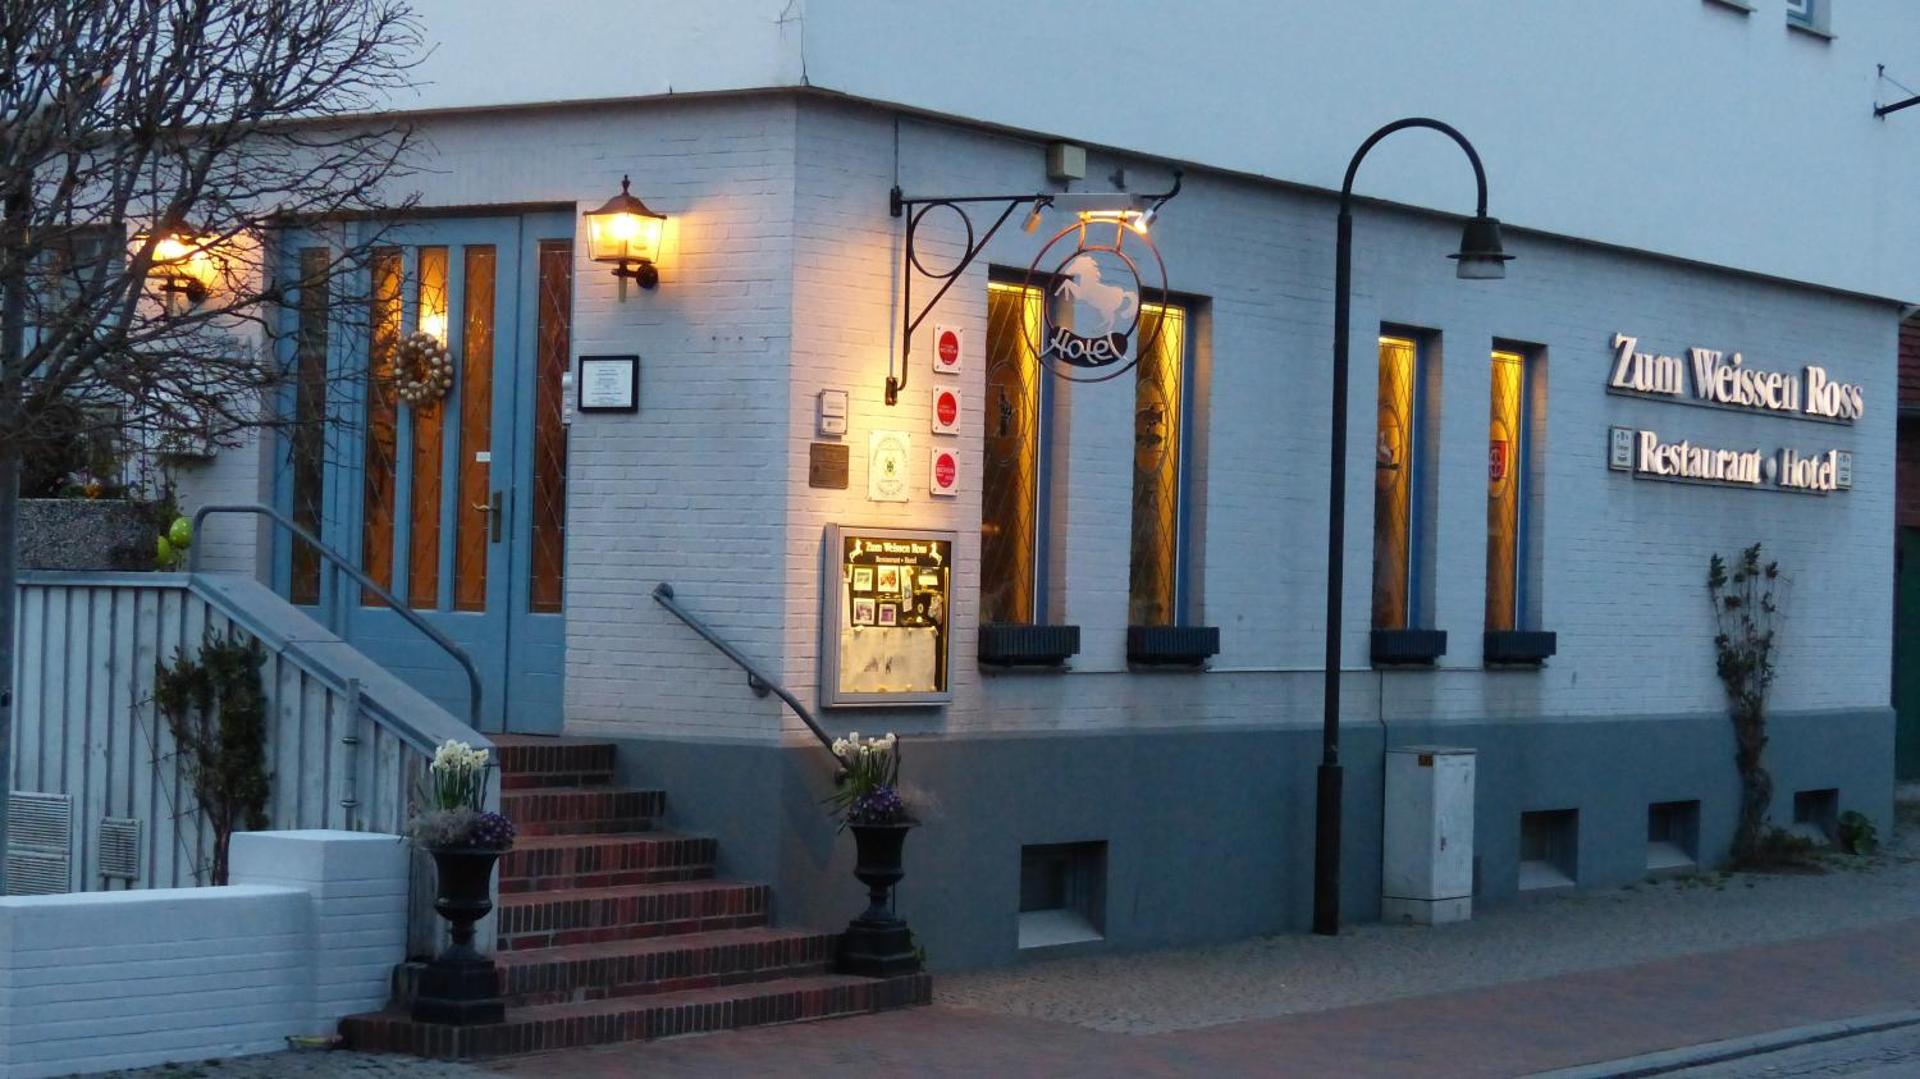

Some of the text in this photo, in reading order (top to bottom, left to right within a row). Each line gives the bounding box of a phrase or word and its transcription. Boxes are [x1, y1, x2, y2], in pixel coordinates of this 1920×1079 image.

[1038, 327, 1130, 363] Hotel
[1611, 332, 1863, 419] Zum Weissen Ross
[1638, 431, 1761, 484] Restaurant
[1777, 448, 1837, 490] Hotel
